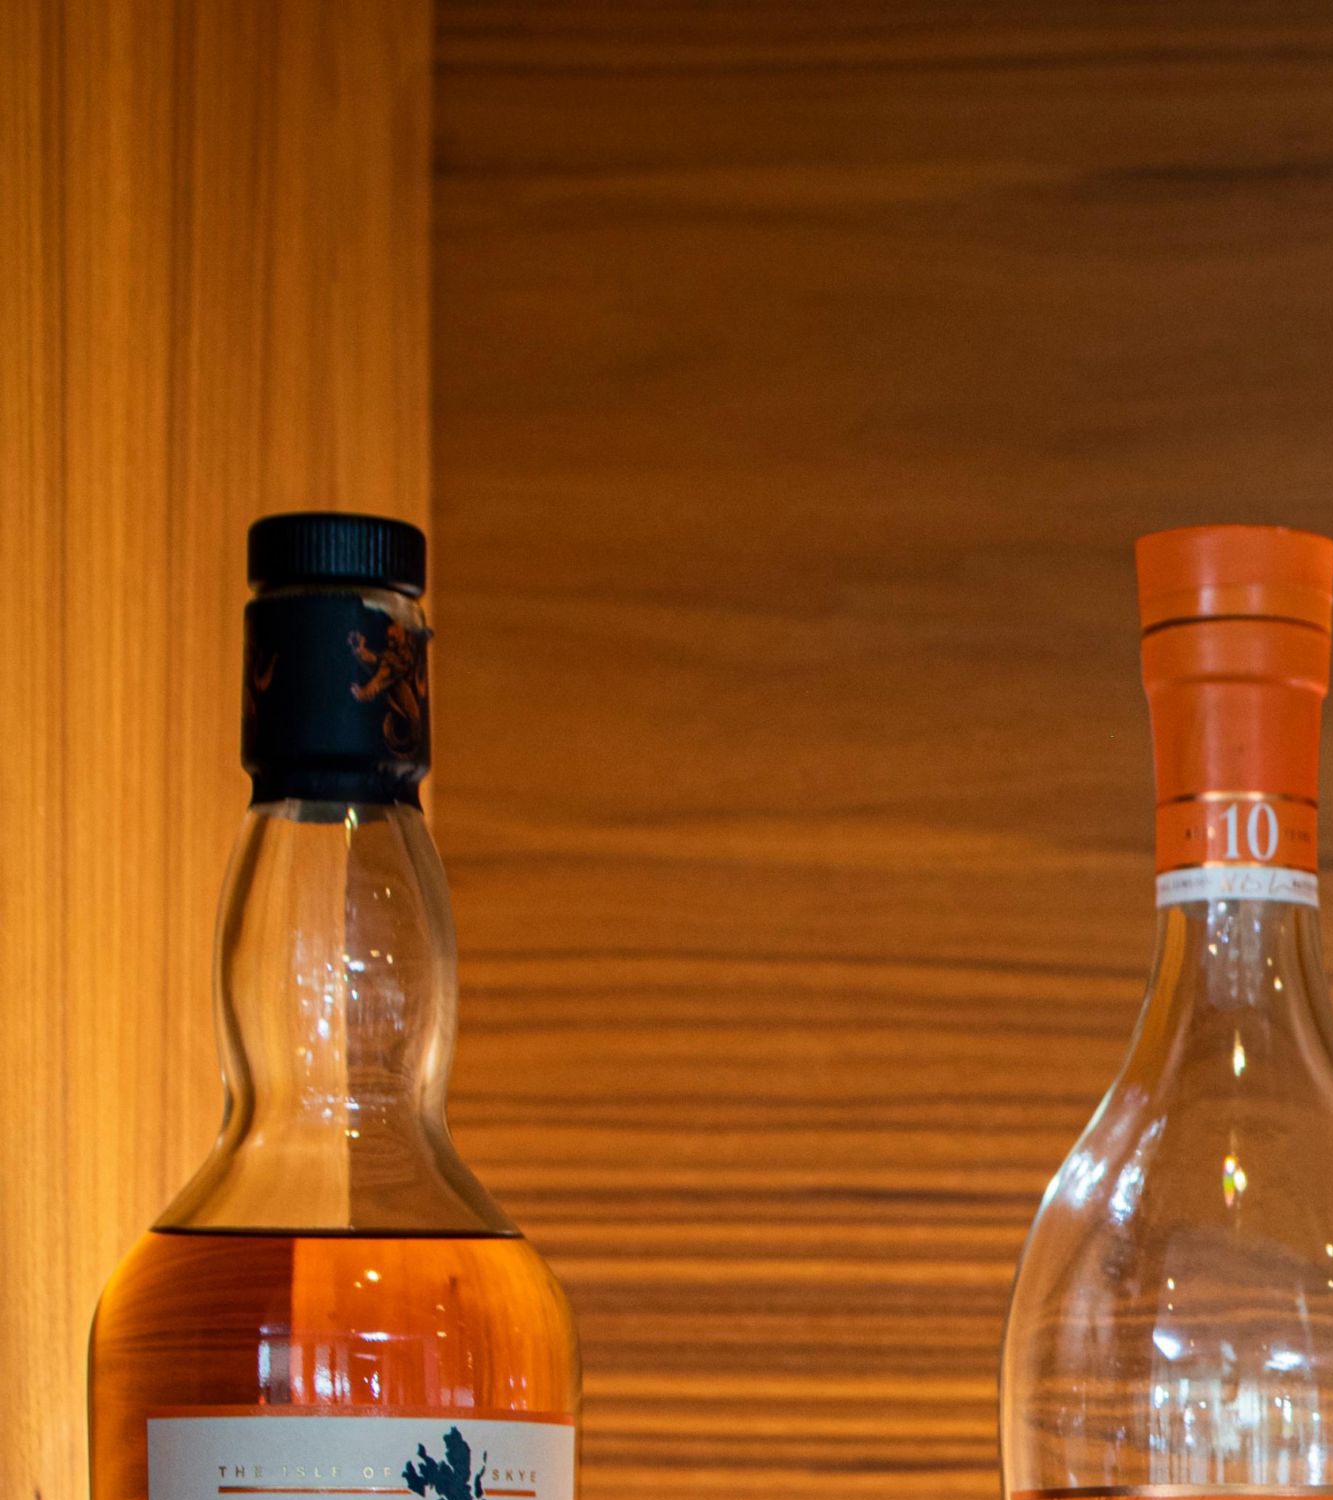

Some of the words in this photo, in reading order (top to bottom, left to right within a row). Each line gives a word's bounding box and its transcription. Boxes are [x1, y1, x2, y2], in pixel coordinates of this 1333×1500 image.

[1219, 801, 1279, 861] 10
[362, 1466, 392, 1480] OF
[491, 1469, 538, 1483] SKYE
